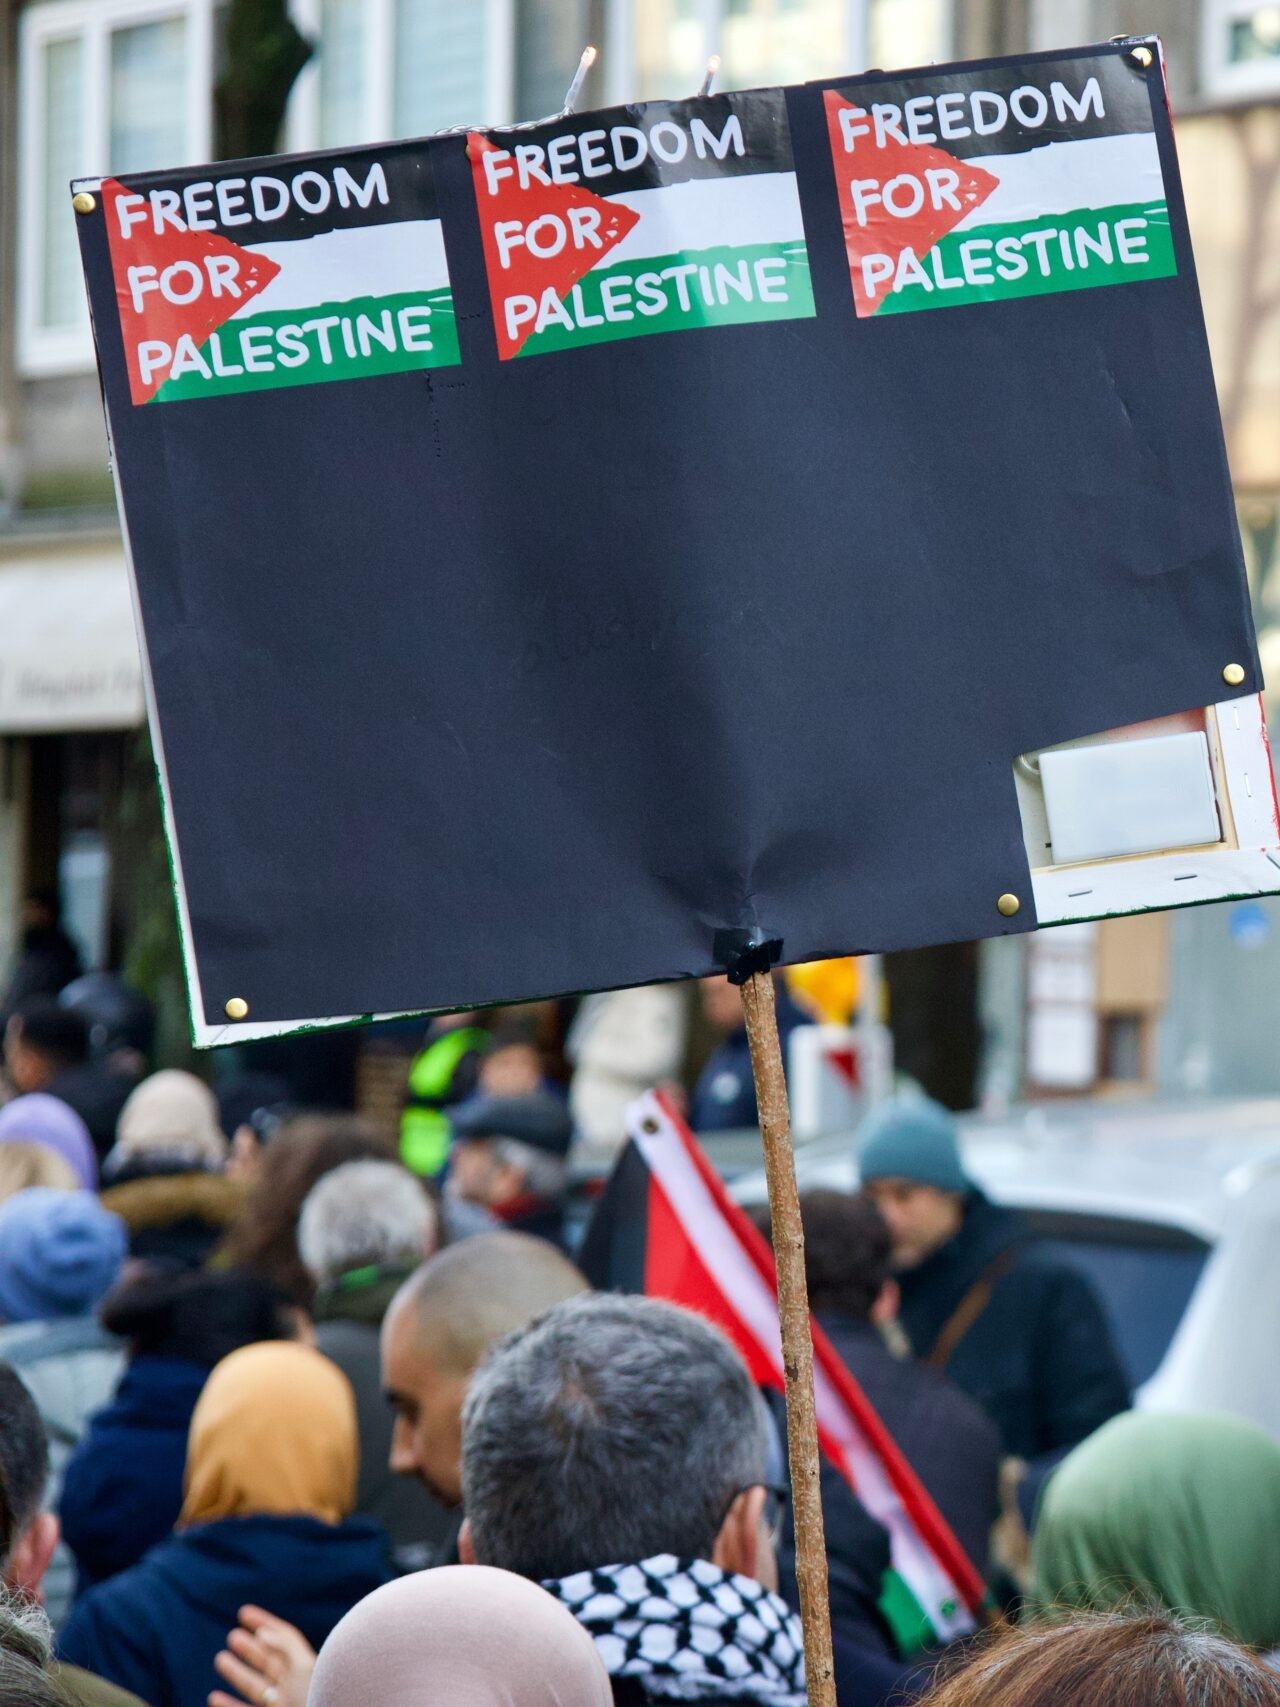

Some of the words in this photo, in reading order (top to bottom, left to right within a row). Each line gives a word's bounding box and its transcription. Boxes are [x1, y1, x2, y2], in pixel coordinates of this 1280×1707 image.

[838, 78, 1105, 152] FREEDOM
[482, 114, 746, 196] FREEDOM
[114, 162, 390, 240] FREEDOM
[851, 169, 962, 227] FOR
[493, 205, 604, 270] FOR
[861, 218, 1149, 298] PALESTINE
[127, 254, 246, 314] FOR
[502, 257, 788, 341] PALESTINE
[137, 306, 434, 385] PALESTINE
